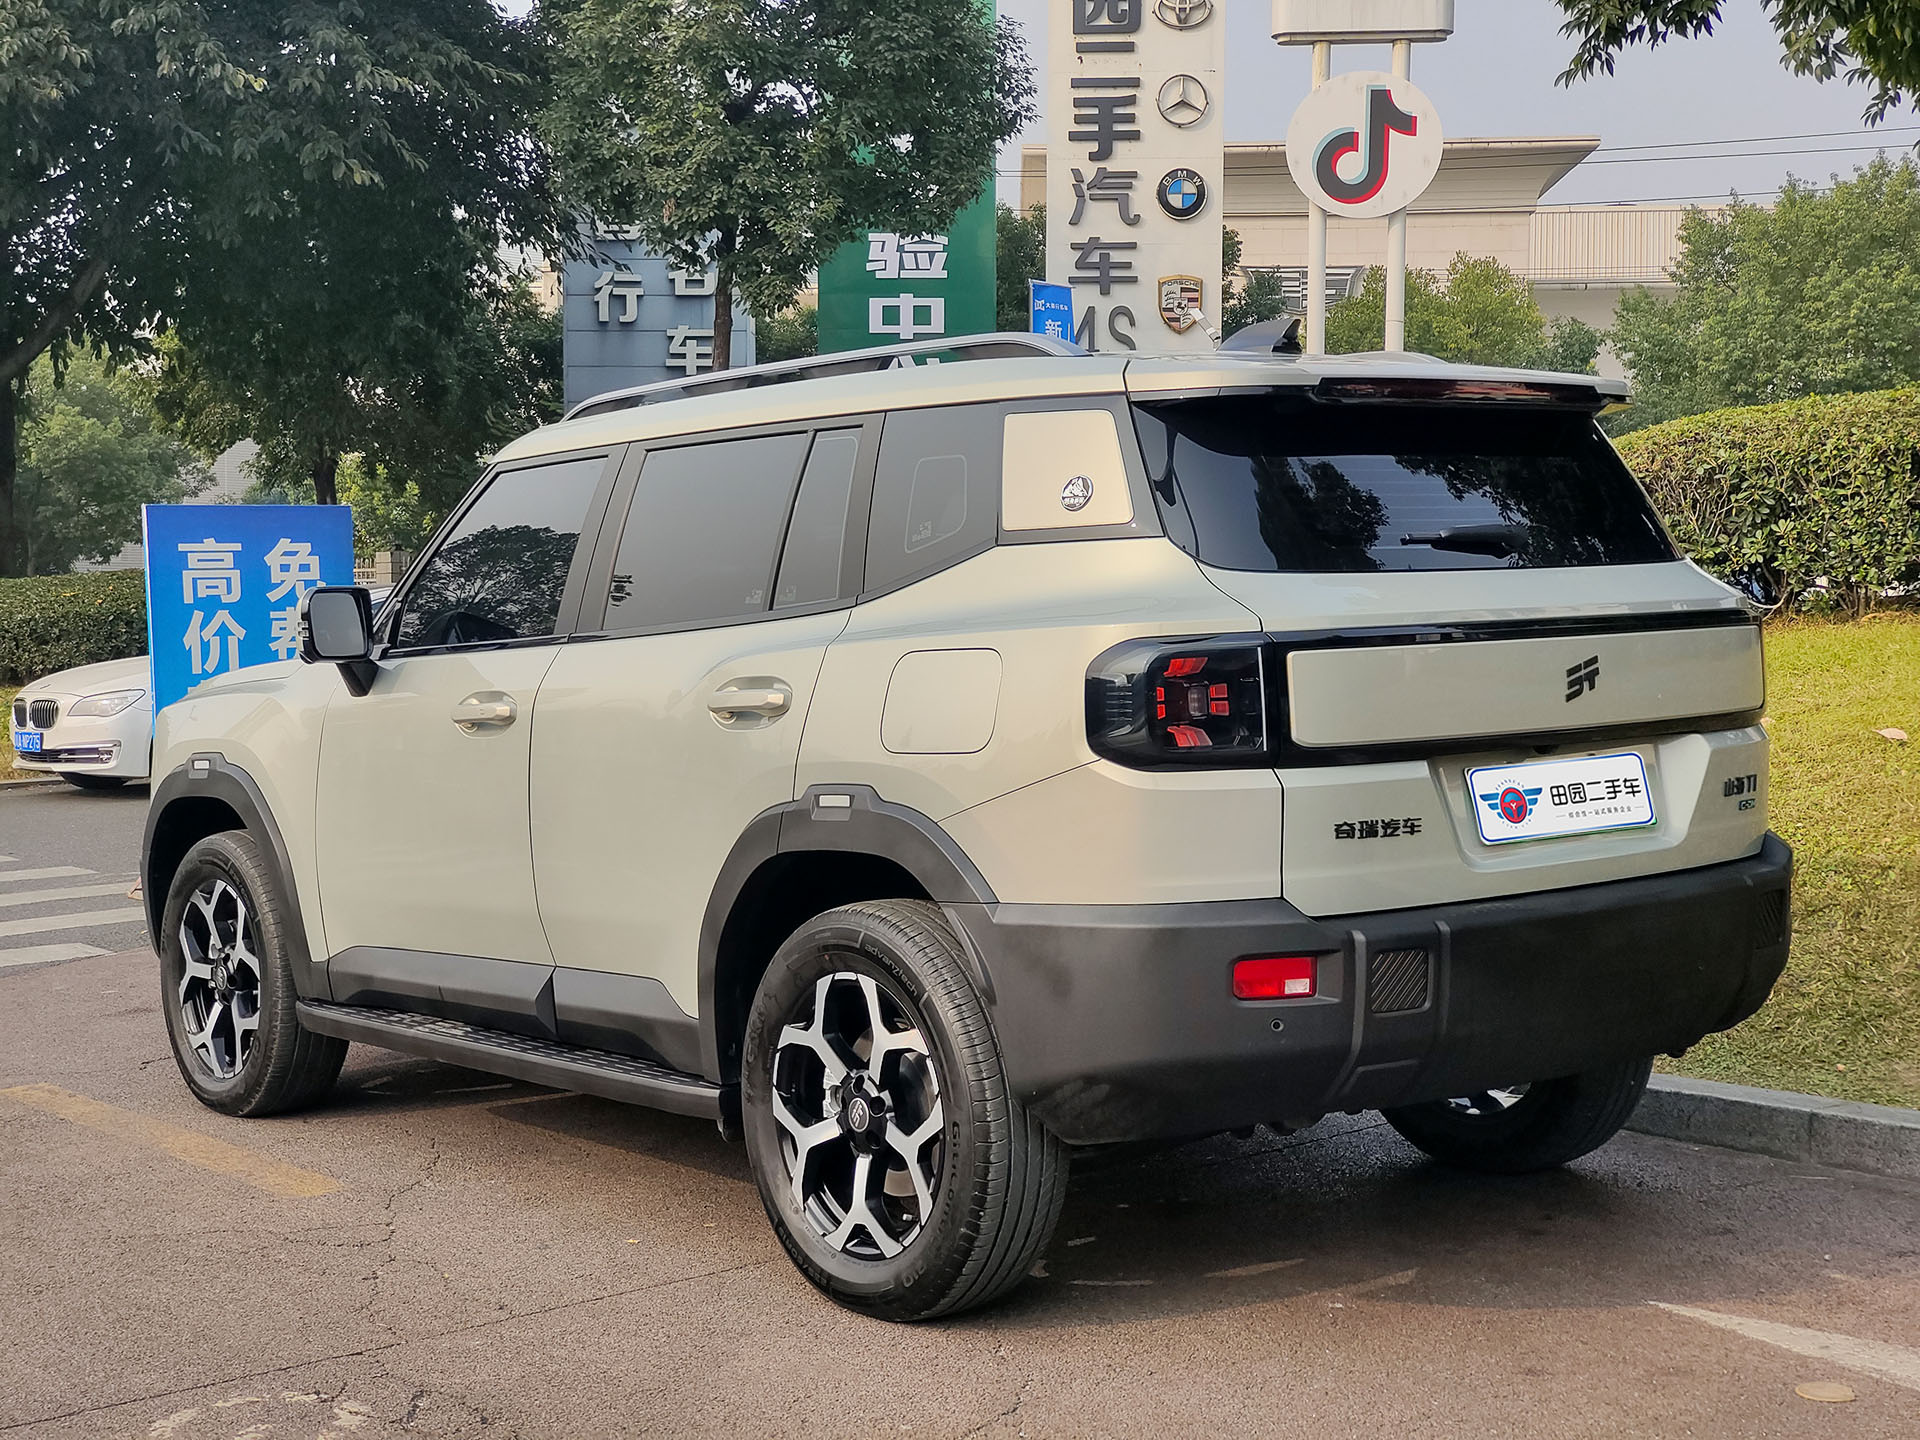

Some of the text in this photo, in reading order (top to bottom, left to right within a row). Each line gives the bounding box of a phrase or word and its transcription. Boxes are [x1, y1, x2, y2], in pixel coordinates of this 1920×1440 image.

[1162, 170, 1203, 187] BMW
[1162, 279, 1200, 289] PORSCHE
[866, 232, 949, 369] 验中
[1550, 778, 1642, 806] 田园二手车
[1334, 818, 1422, 839] 奇瑞汽车
[864, 943, 918, 997] advanztech
